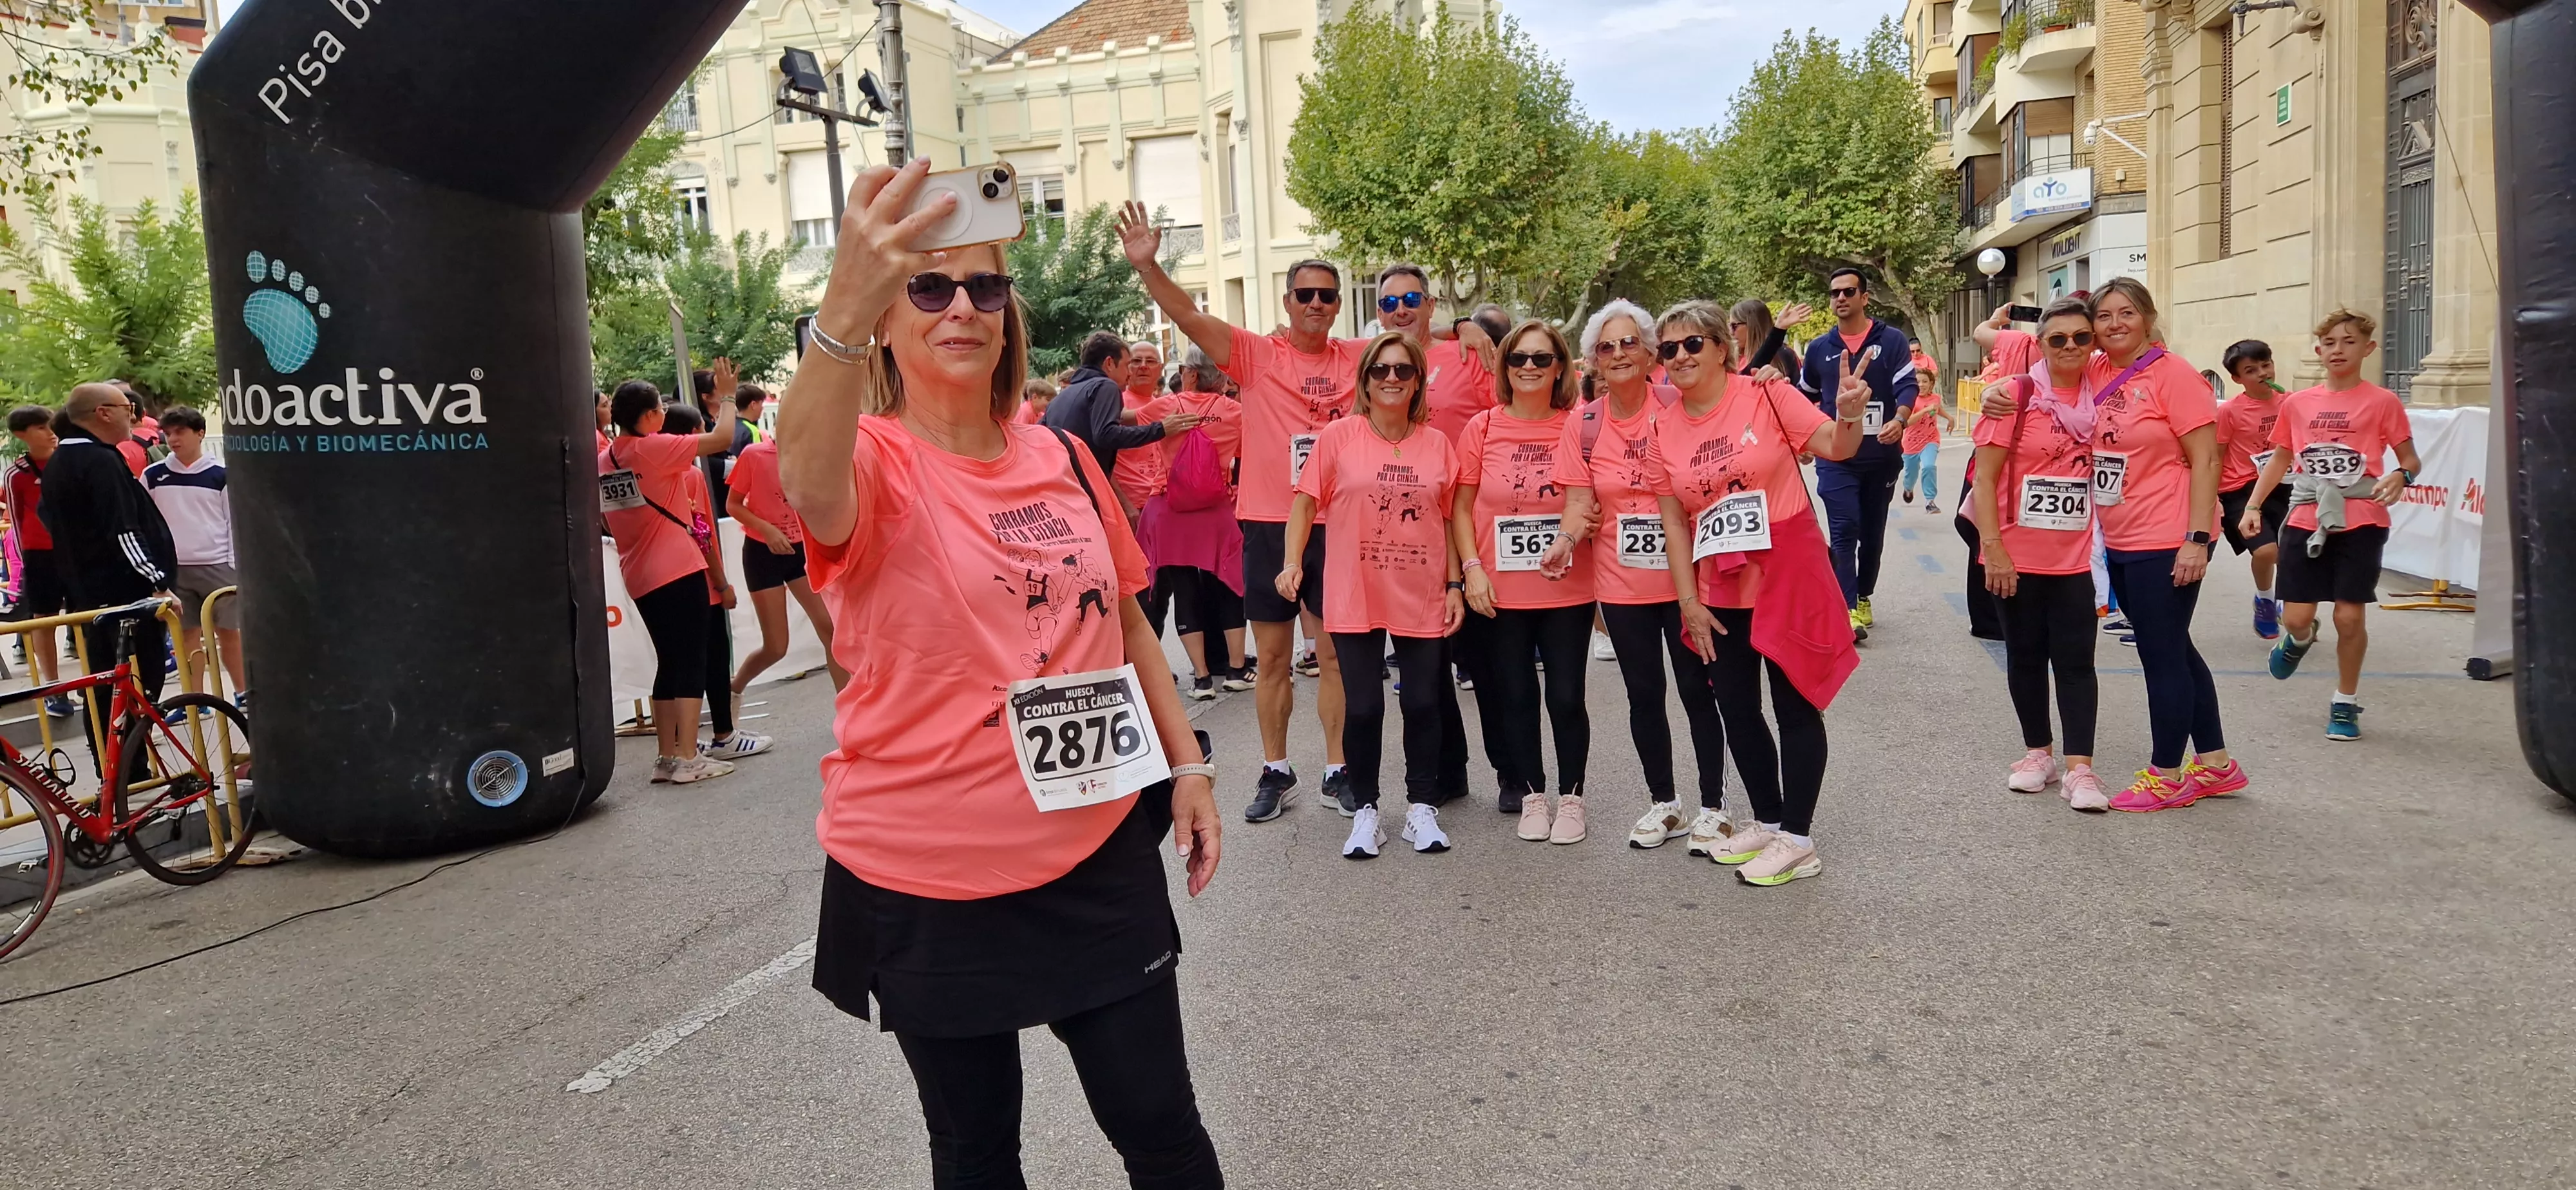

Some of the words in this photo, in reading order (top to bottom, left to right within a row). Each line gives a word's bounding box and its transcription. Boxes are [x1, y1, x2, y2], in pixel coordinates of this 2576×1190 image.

[258, 30, 346, 124] Pisa
[329, 0, 381, 29] b
[297, 435, 308, 451] Y
[317, 430, 489, 452] BIOMECÁNICA
[1518, 444, 1549, 453] CORRAMOS
[1510, 453, 1522, 462] POR
[1690, 455, 1701, 468] POR
[1703, 453, 1709, 463] LA
[1711, 443, 1733, 460] CIENCIA
[2306, 457, 2360, 475] 3389
[1376, 472, 1388, 481] POR
[1389, 473, 1395, 482] LA
[1397, 474, 1419, 483] CIENCIA
[1383, 464, 1414, 474] CORRAMOS
[603, 481, 635, 500] 3931
[1729, 502, 1758, 510] CÁNCER
[2028, 494, 2085, 515] 2304
[989, 501, 1053, 531] CORRAMOS
[1013, 528, 1032, 543] LA
[1028, 517, 1074, 542] CIENCIA
[1700, 511, 1761, 545] 2093
[1020, 688, 1044, 703] EDICIÓN
[1065, 686, 1095, 699] HUESCA
[1023, 700, 1075, 719] CONTRA
[1078, 697, 1089, 710] EL
[1090, 692, 1126, 709] CÁNCER
[1025, 710, 1141, 774] 2876
[13, 753, 91, 819] SPECIALIZED
[1144, 950, 1171, 974] HEAD
